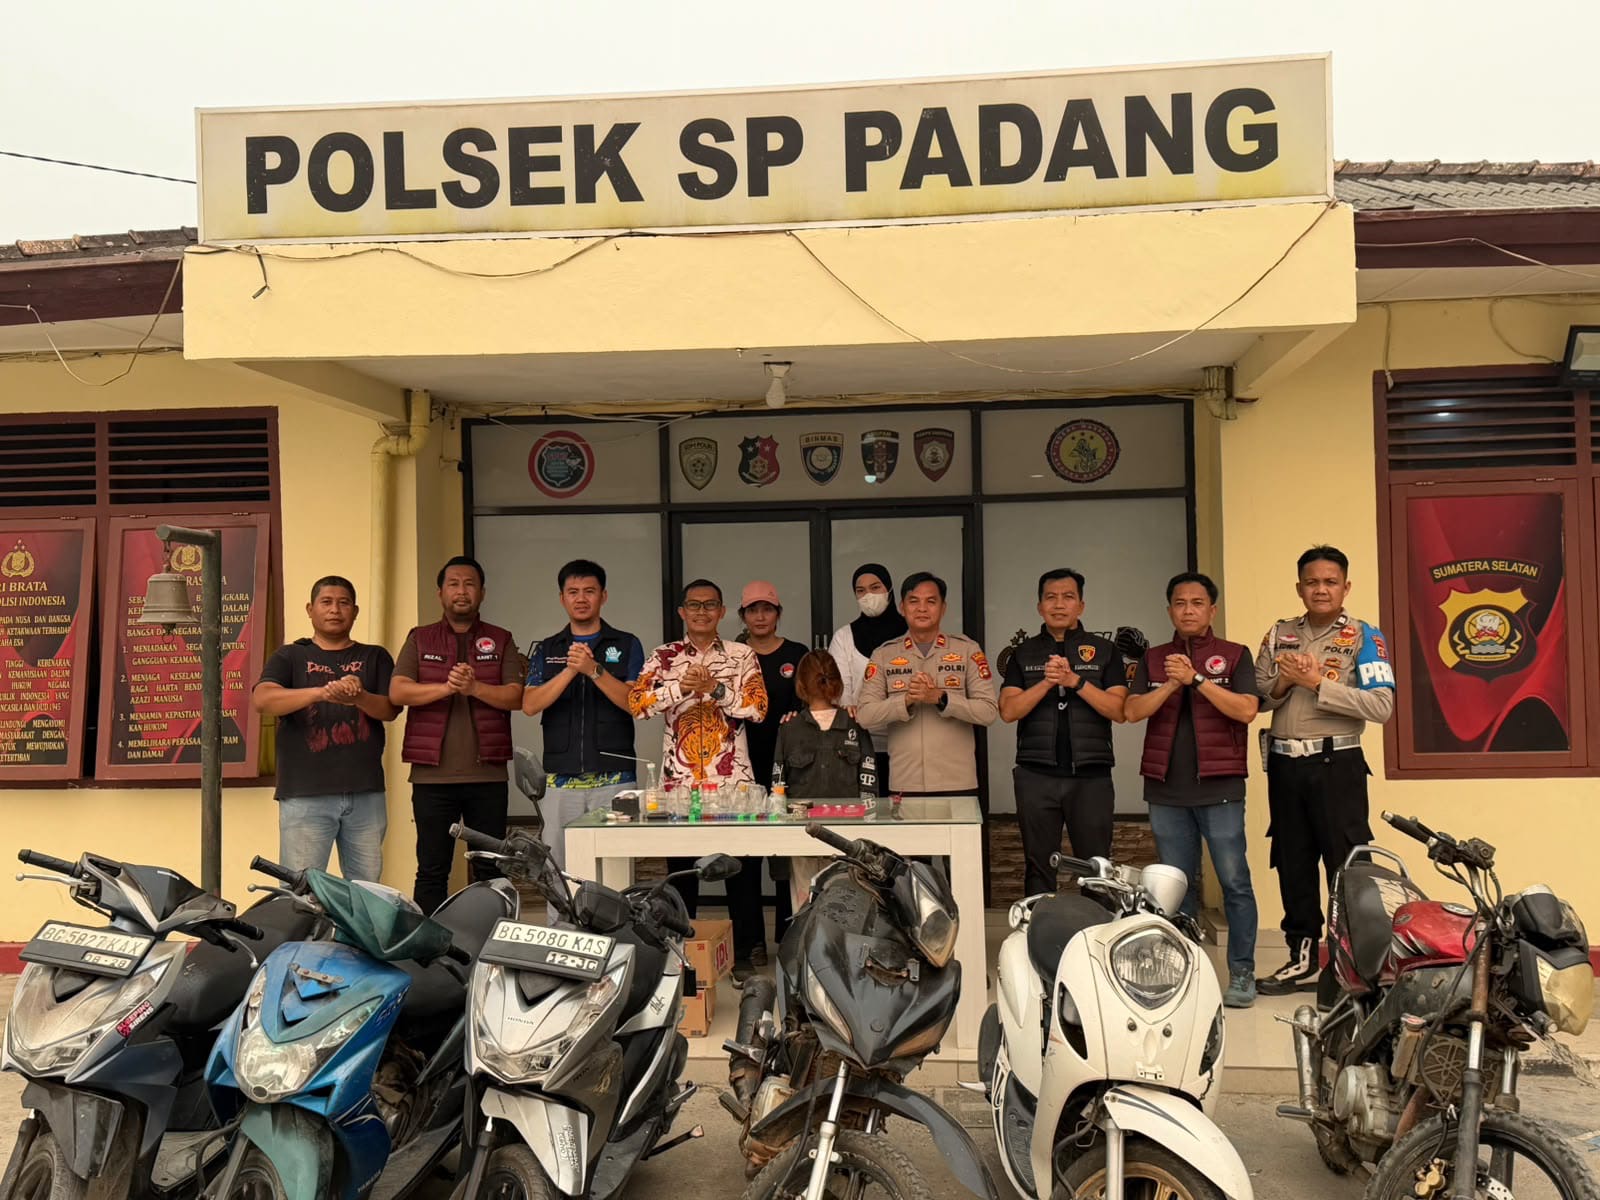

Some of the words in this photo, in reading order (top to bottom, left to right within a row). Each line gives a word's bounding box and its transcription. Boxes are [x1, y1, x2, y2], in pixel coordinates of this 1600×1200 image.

[245, 122, 645, 214] POLSEK
[677, 115, 803, 200] SP
[844, 87, 1279, 192] PADANG
[1432, 560, 1490, 579] SUMATERA
[1491, 560, 1538, 577] SELATAN
[9, 581, 48, 592] BRATA
[0, 597, 18, 607] LISI
[19, 595, 66, 606] INDONESIA
[15, 615, 31, 624] NUSA
[34, 615, 47, 623] DAN
[42, 626, 72, 635] TERHADAP
[127, 628, 155, 637] BANGSA
[13, 638, 24, 647] ESA
[1323, 645, 1353, 656] POLRI
[132, 656, 168, 665] GANGGUAN
[169, 655, 202, 664] KEAMANA
[423, 654, 443, 662] RIZAL
[886, 668, 912, 676] DARLAN
[938, 664, 965, 673] POLRI
[50, 669, 71, 678] DALAM
[47, 680, 71, 689] NEGARA
[130, 684, 149, 693] RAGA
[156, 683, 178, 692] HARTA
[229, 681, 244, 690] HAK
[20, 692, 50, 701] INDONESIA
[153, 694, 183, 703] MANUSIA
[164, 710, 201, 719] KEPASTIAN
[143, 722, 168, 731] HUKUM
[42, 730, 66, 739] DENGAN
[127, 738, 171, 748] MEMELIHARA
[171, 737, 202, 746] PERASAA
[127, 751, 141, 760] DAN
[141, 750, 164, 759] DAMAI
[498, 926, 522, 942] BG
[572, 936, 606, 955] KAS
[107, 937, 143, 955] KAX
